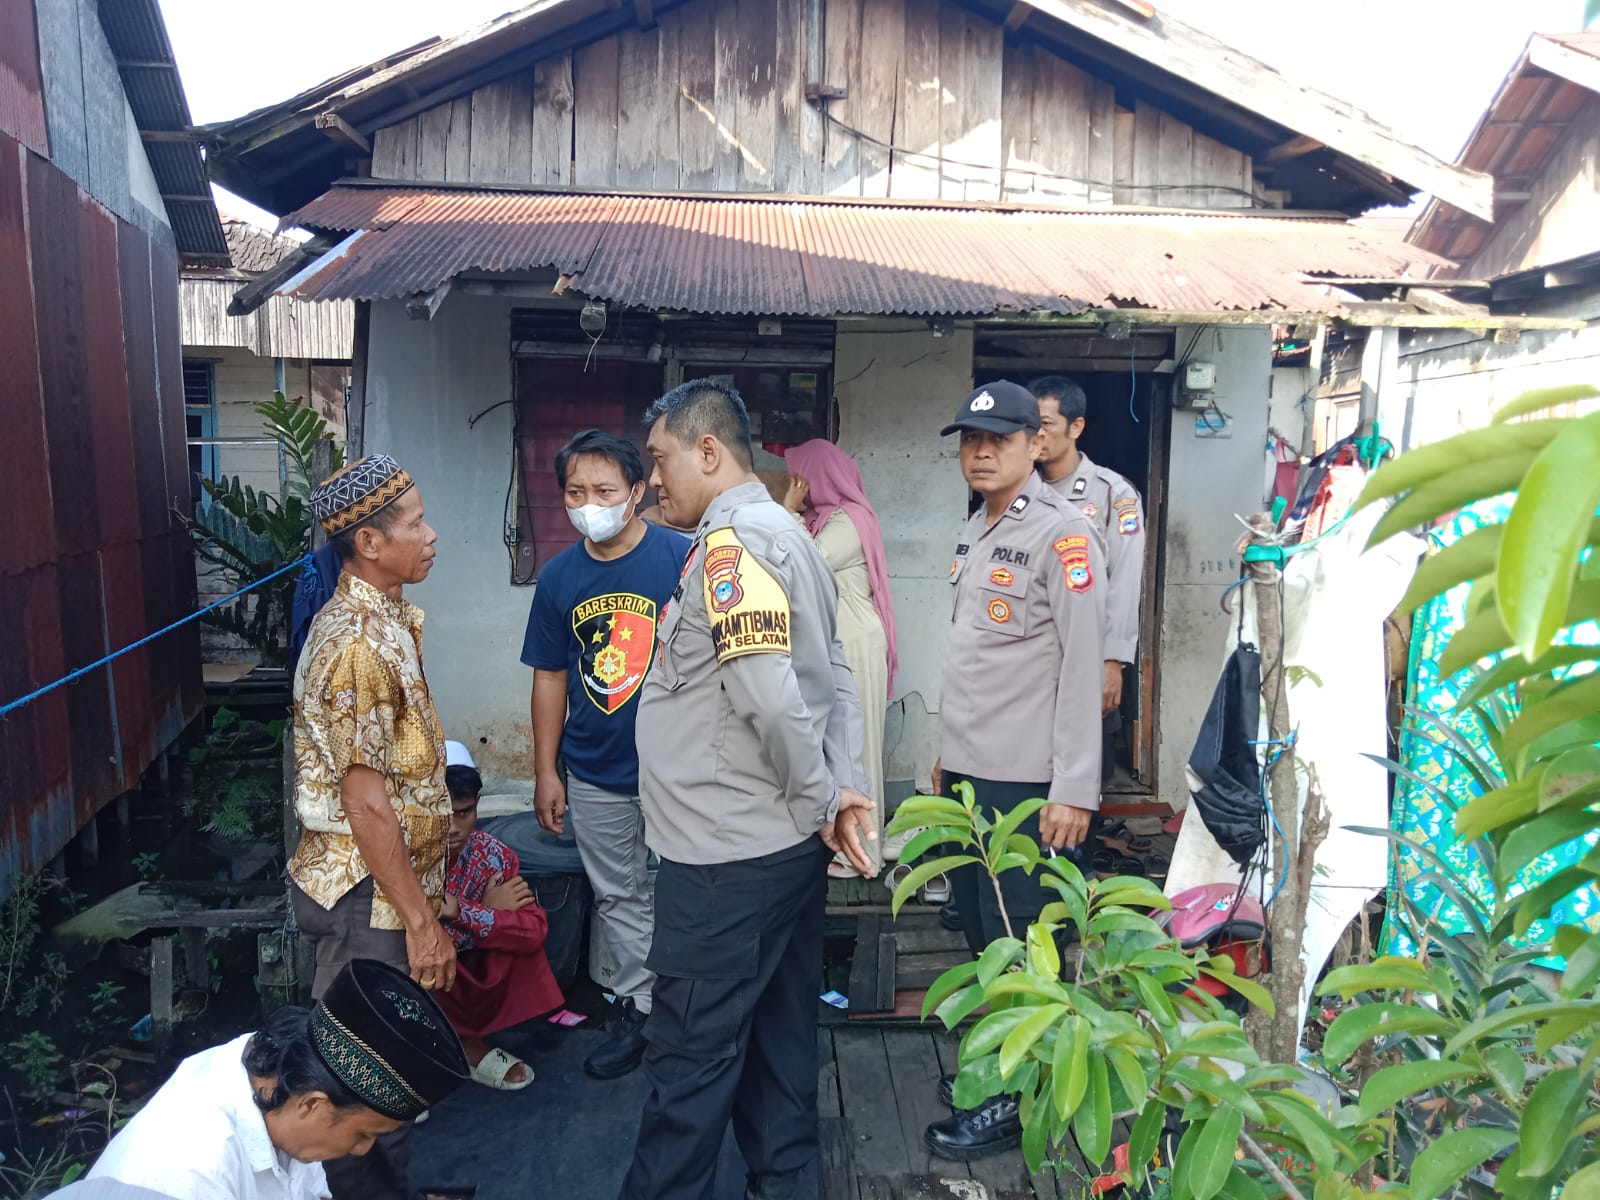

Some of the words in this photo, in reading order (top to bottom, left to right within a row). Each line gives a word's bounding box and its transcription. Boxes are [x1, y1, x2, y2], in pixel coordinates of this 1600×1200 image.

[991, 546, 1030, 567] POLRI
[576, 596, 650, 620] BARESKRIM
[735, 633, 788, 648] SELATAN
